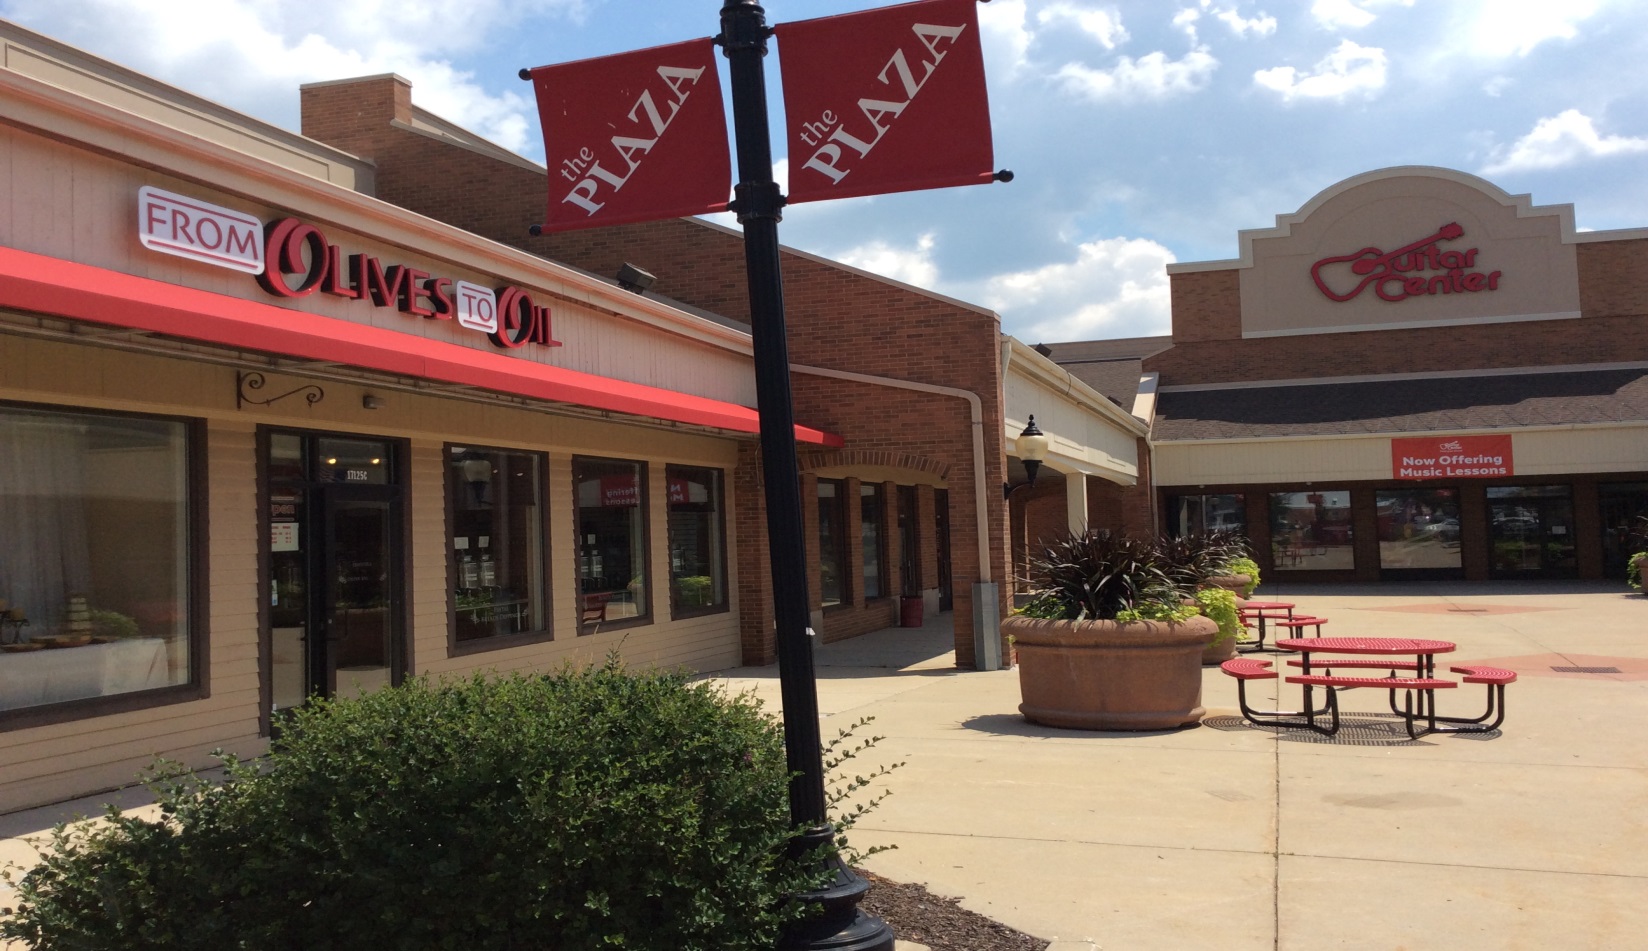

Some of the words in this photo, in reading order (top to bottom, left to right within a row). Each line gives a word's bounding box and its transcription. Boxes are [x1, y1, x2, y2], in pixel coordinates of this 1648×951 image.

[801, 22, 967, 186] PLAZA
[562, 64, 707, 217] PLAZA
[799, 109, 838, 147] the
[561, 145, 594, 183] the
[147, 202, 259, 261] FROM
[257, 217, 453, 320] OLIVES
[462, 292, 494, 325] TO
[489, 285, 562, 349] OIL
[1375, 268, 1502, 302] Center
[1400, 467, 1443, 477] Music
[1446, 466, 1507, 476] Lessons
[1402, 456, 1436, 466] Now
[1439, 454, 1503, 466] Offering
[271, 504, 295, 516] pen
